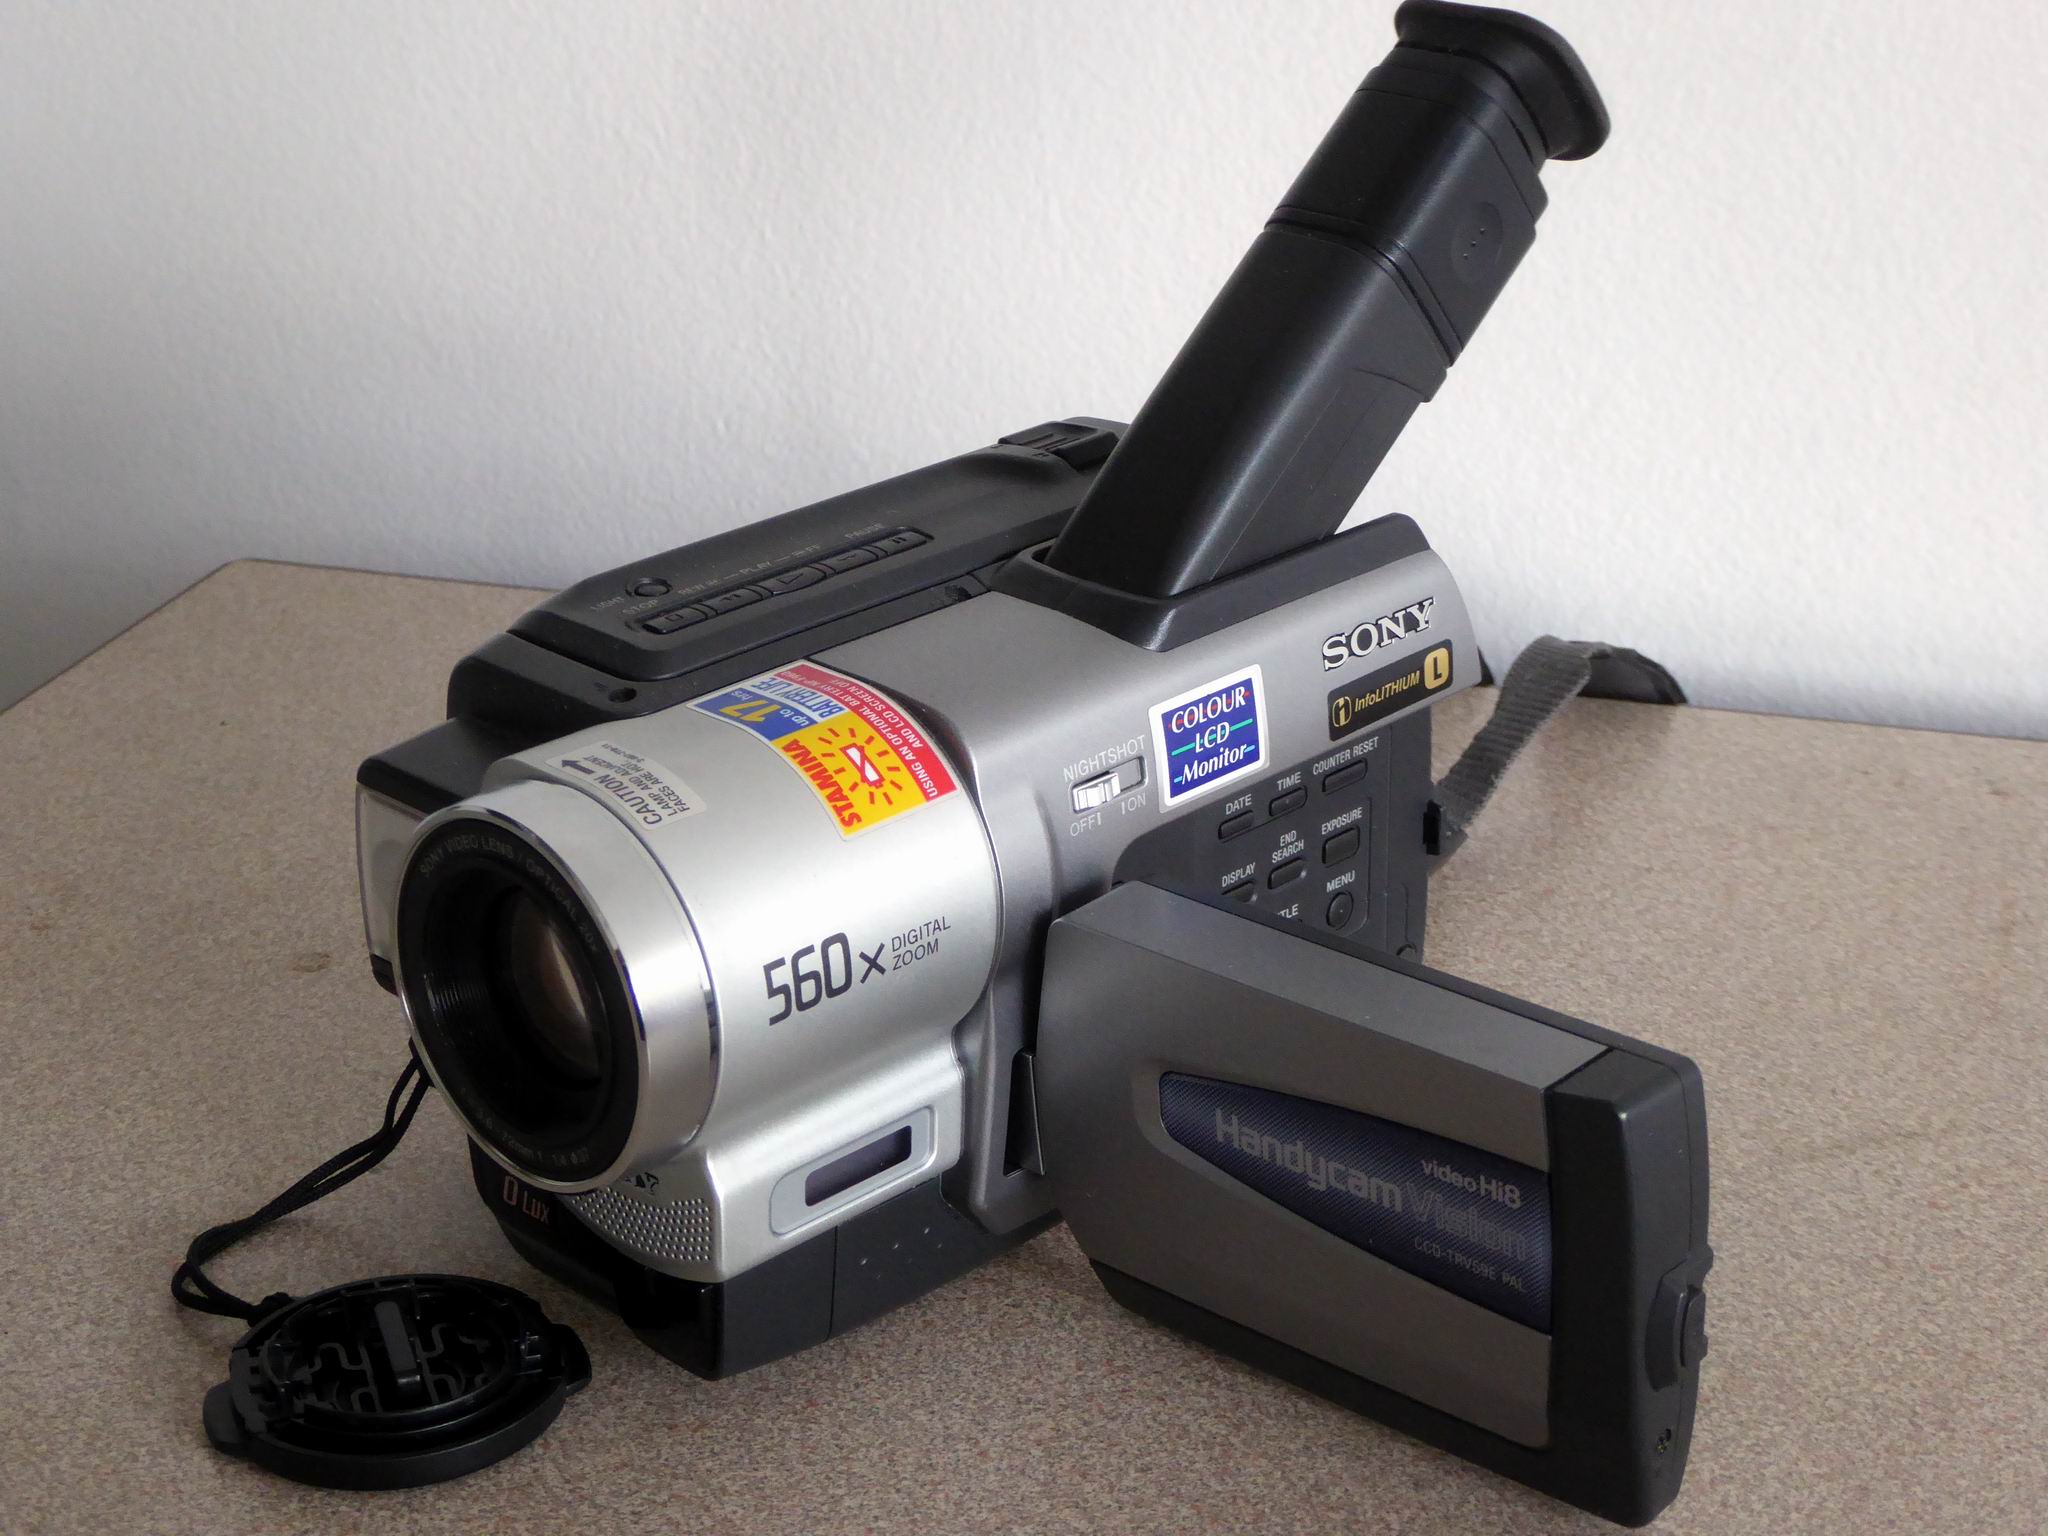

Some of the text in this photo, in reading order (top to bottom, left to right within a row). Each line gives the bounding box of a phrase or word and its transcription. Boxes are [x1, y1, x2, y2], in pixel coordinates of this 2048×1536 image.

[1322, 596, 1436, 672] SONY
[783, 687, 846, 719] BATTERY
[847, 683, 887, 709] SCREEN
[1354, 670, 1420, 713] InfoLITHIUM
[719, 700, 781, 723] 17
[779, 708, 796, 718] to
[791, 713, 810, 727] up
[882, 707, 905, 731] LCD
[1171, 686, 1247, 734] COLOUR
[858, 705, 904, 746] OPTIONAL
[900, 726, 924, 749] AND
[1194, 721, 1231, 754] LCD
[899, 747, 917, 762] AN
[1063, 734, 1145, 783] NIGHTSHOT
[1181, 743, 1248, 785] Monitor
[1312, 736, 1379, 776] COUNTER RESET
[629, 776, 652, 791] AND
[641, 770, 664, 786] ARE
[781, 738, 863, 828] STAMINA
[911, 761, 938, 798] USING
[1276, 772, 1302, 792] TIME
[593, 773, 663, 825] CAUTION
[648, 792, 677, 817] LAMP
[658, 785, 691, 814] FACES
[1225, 794, 1253, 815] DATE
[1321, 806, 1363, 835] EXPOSURE
[1271, 839, 1305, 864] SEARCH
[1279, 830, 1297, 847] END
[419, 845, 445, 879] SONY
[444, 834, 479, 853] VIDEO
[1221, 862, 1256, 888] DISPLAY
[1326, 870, 1356, 893] MENU
[892, 938, 940, 971] ZOOM
[763, 932, 853, 1027] 560
[891, 916, 952, 953] DIGITAL
[1215, 1107, 1403, 1214] Handycam
